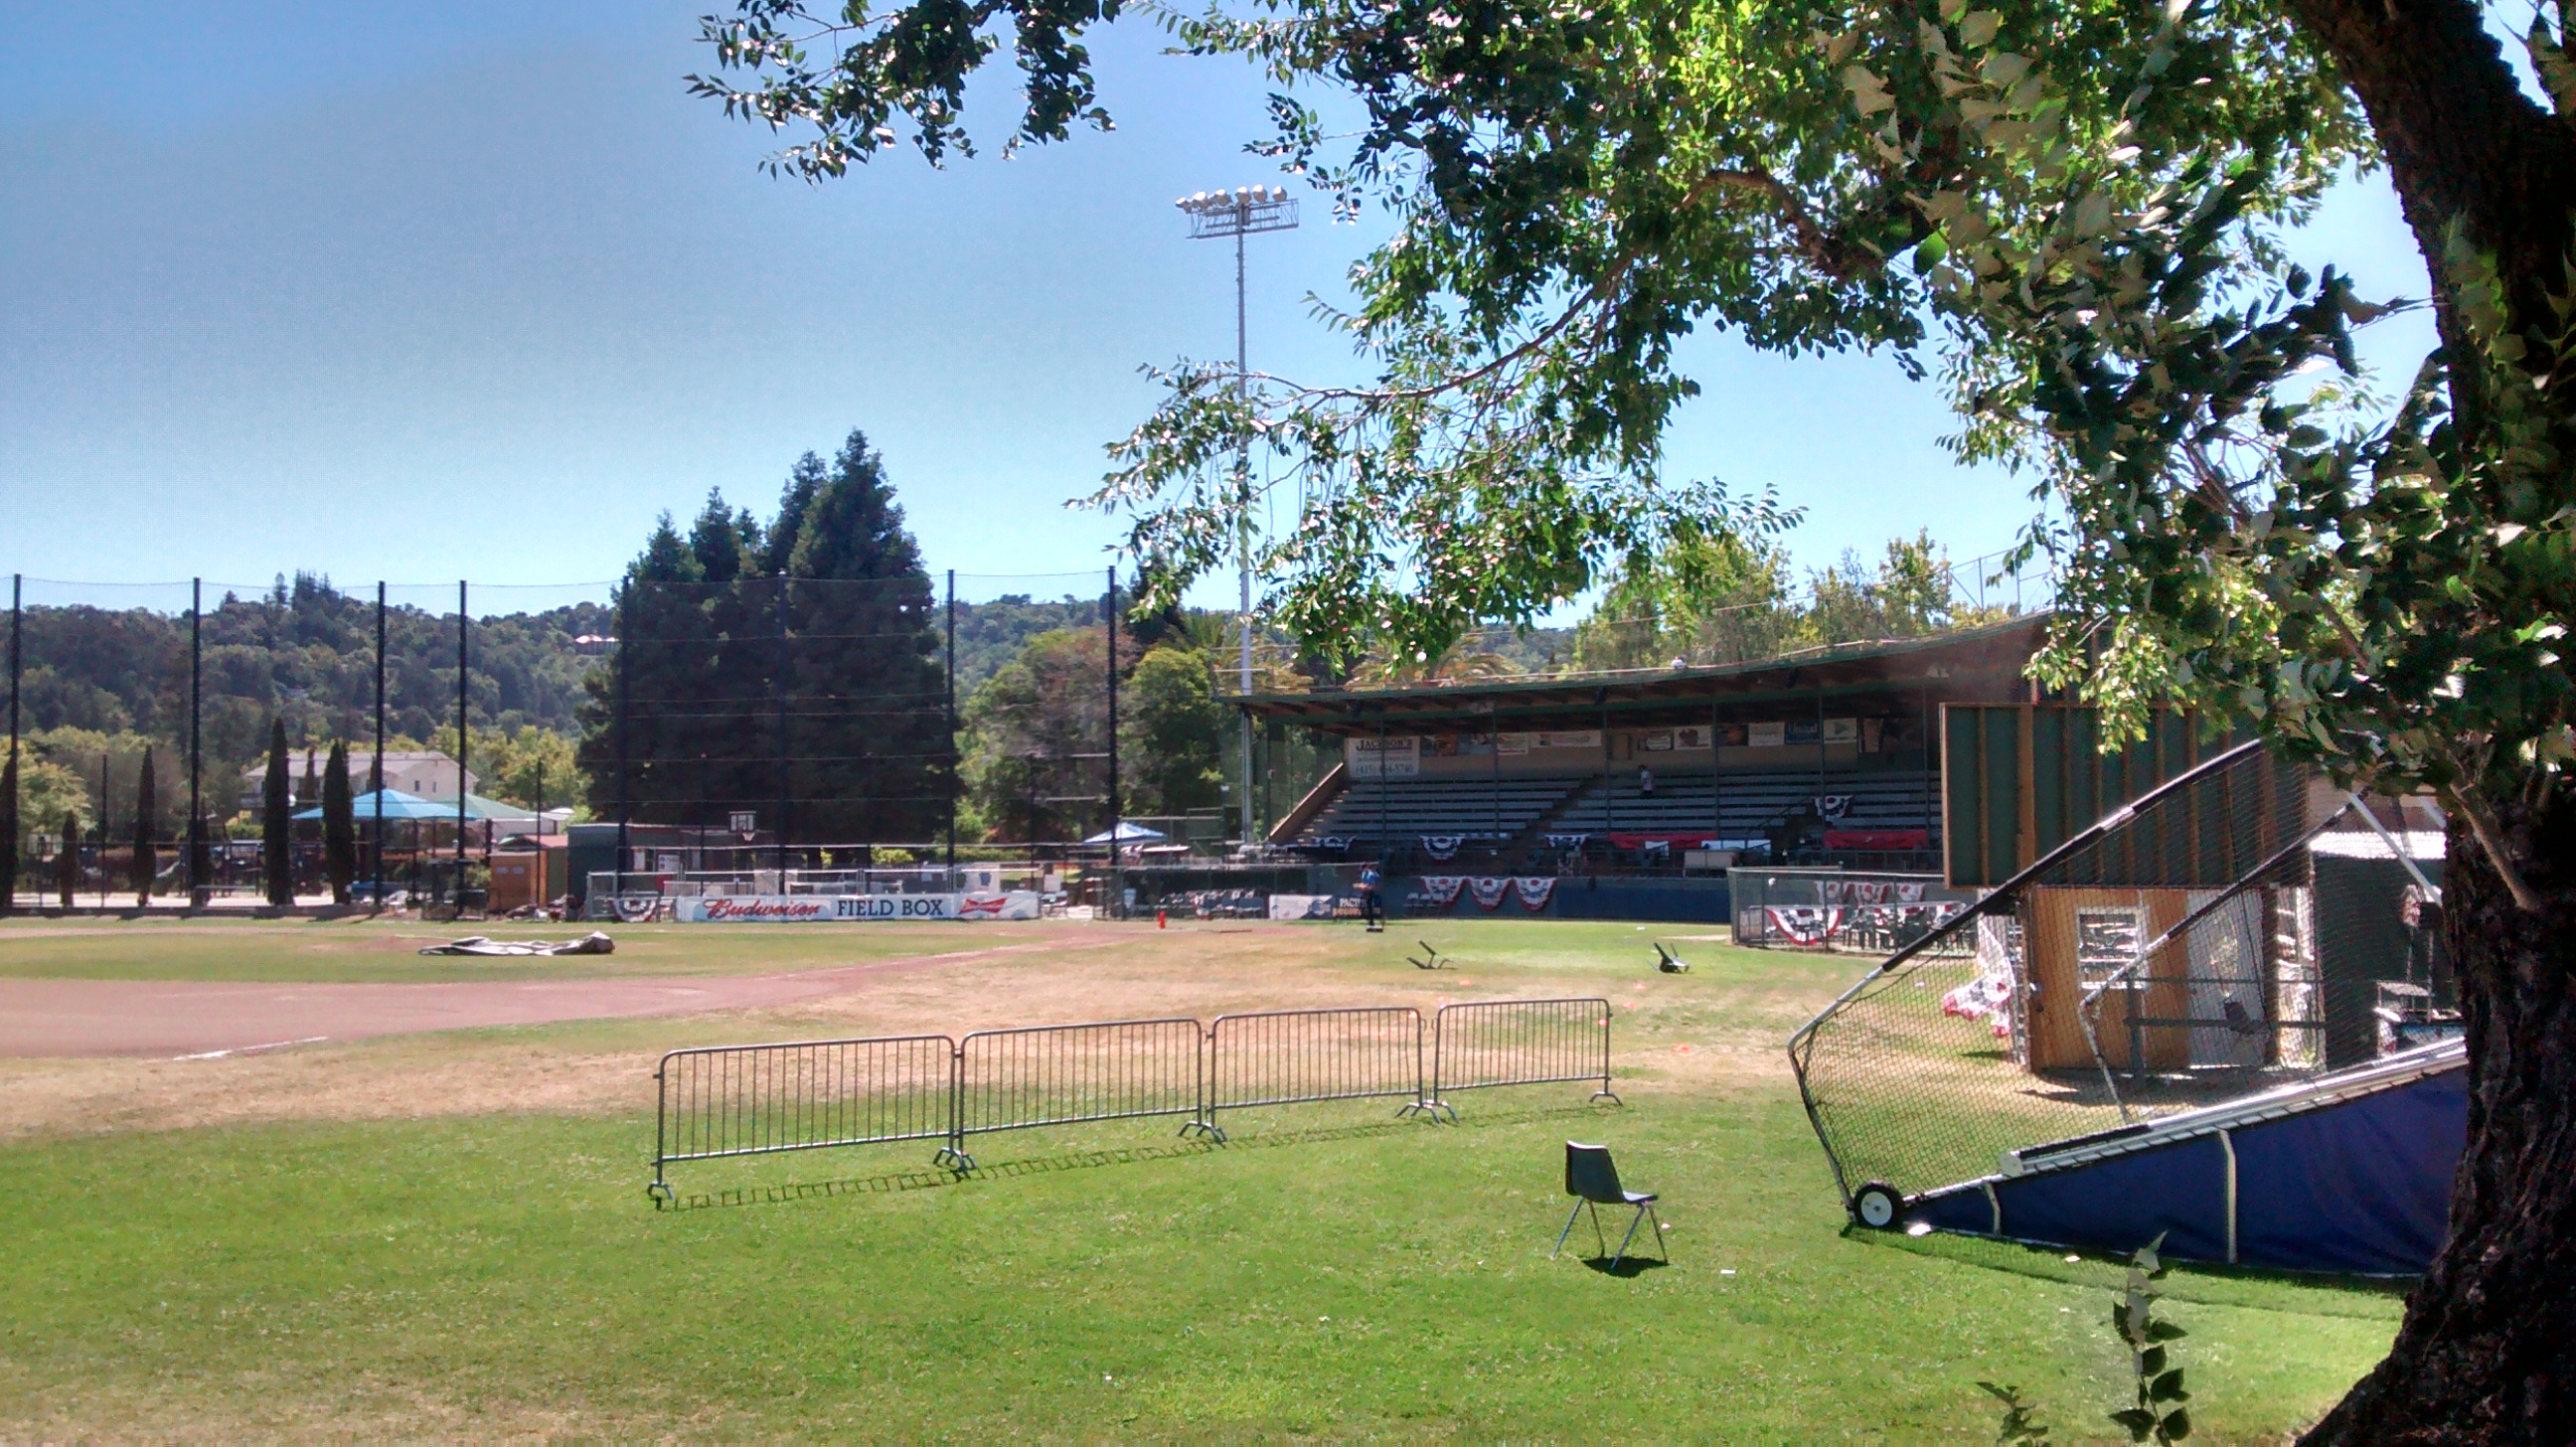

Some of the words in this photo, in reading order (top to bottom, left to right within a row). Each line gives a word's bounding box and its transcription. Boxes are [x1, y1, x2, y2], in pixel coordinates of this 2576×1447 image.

[703, 898, 821, 919] Budweiser
[837, 899, 894, 916] FIELD
[901, 898, 944, 915] BOX
